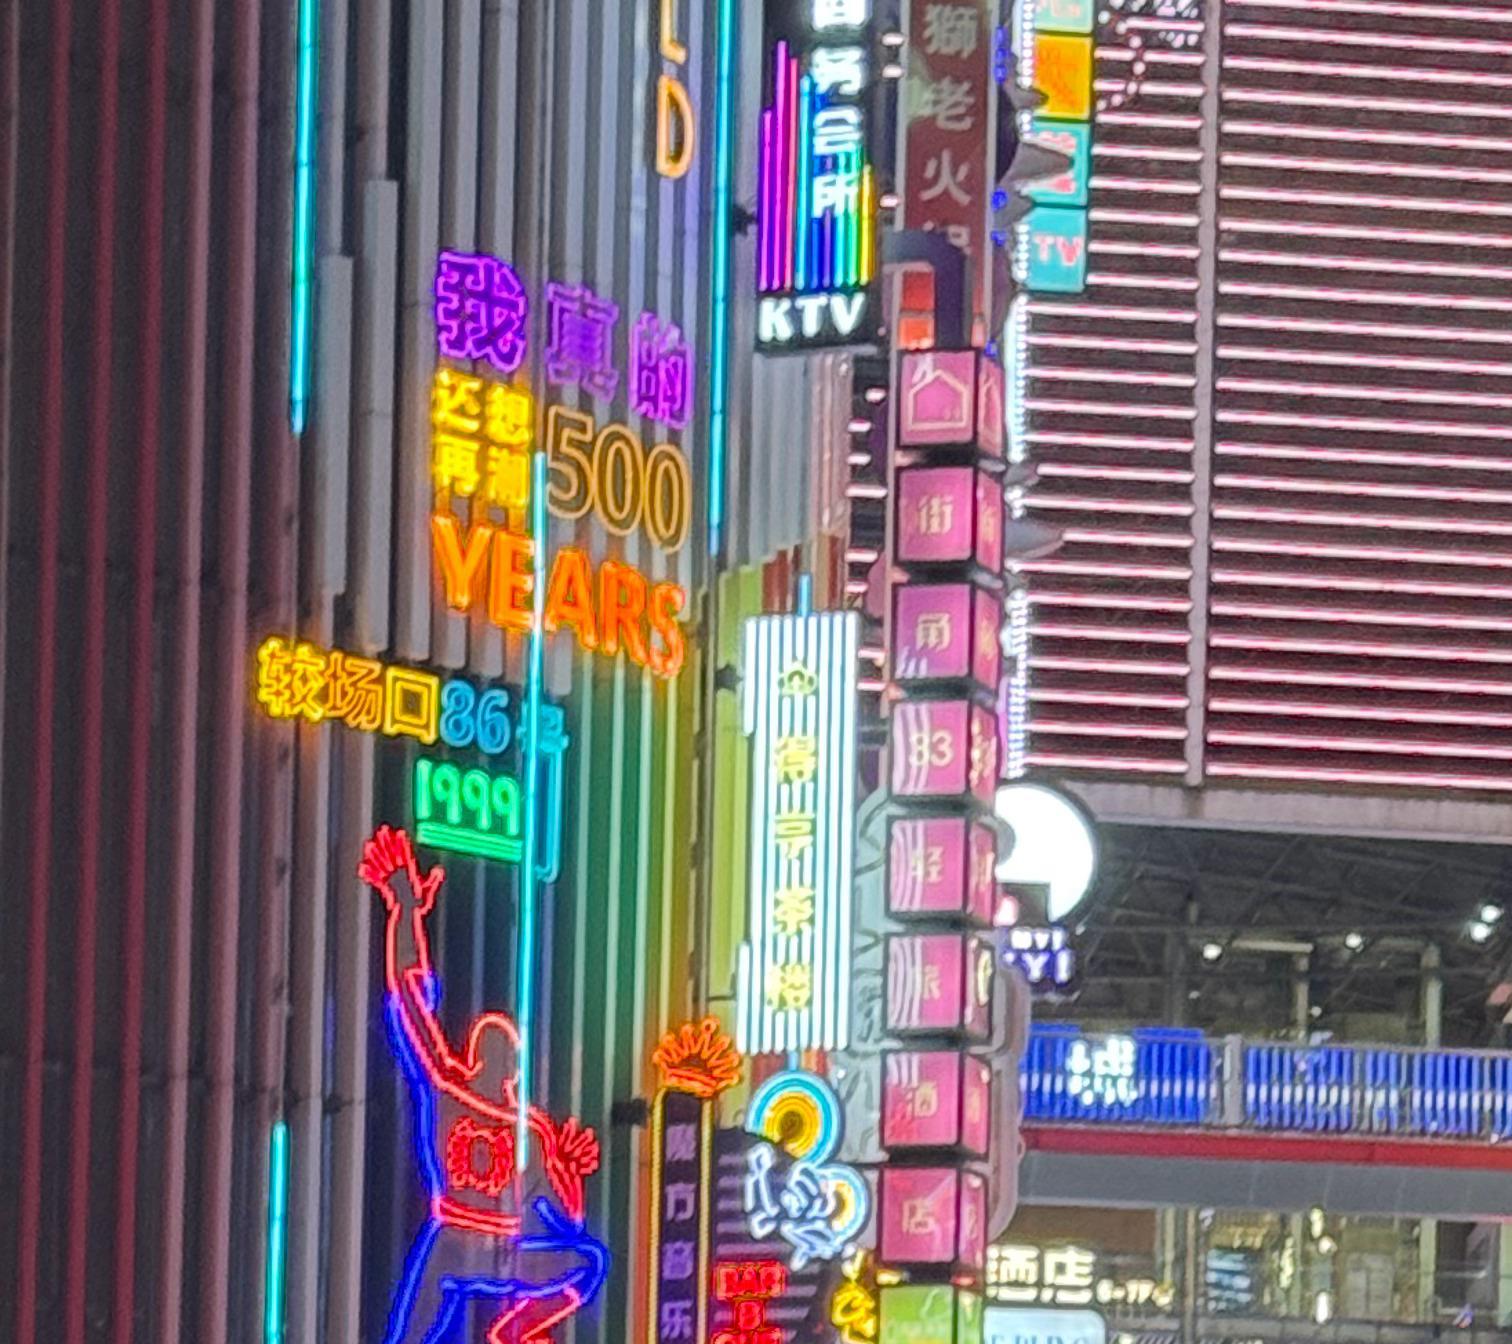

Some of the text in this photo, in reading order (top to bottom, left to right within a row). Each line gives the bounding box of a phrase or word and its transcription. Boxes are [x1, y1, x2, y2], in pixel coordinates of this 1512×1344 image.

[758, 293, 866, 342] KTV
[546, 404, 692, 555] 500
[431, 513, 688, 679] YEARS
[413, 757, 518, 836] 1999
[716, 1261, 788, 1301] BAR
